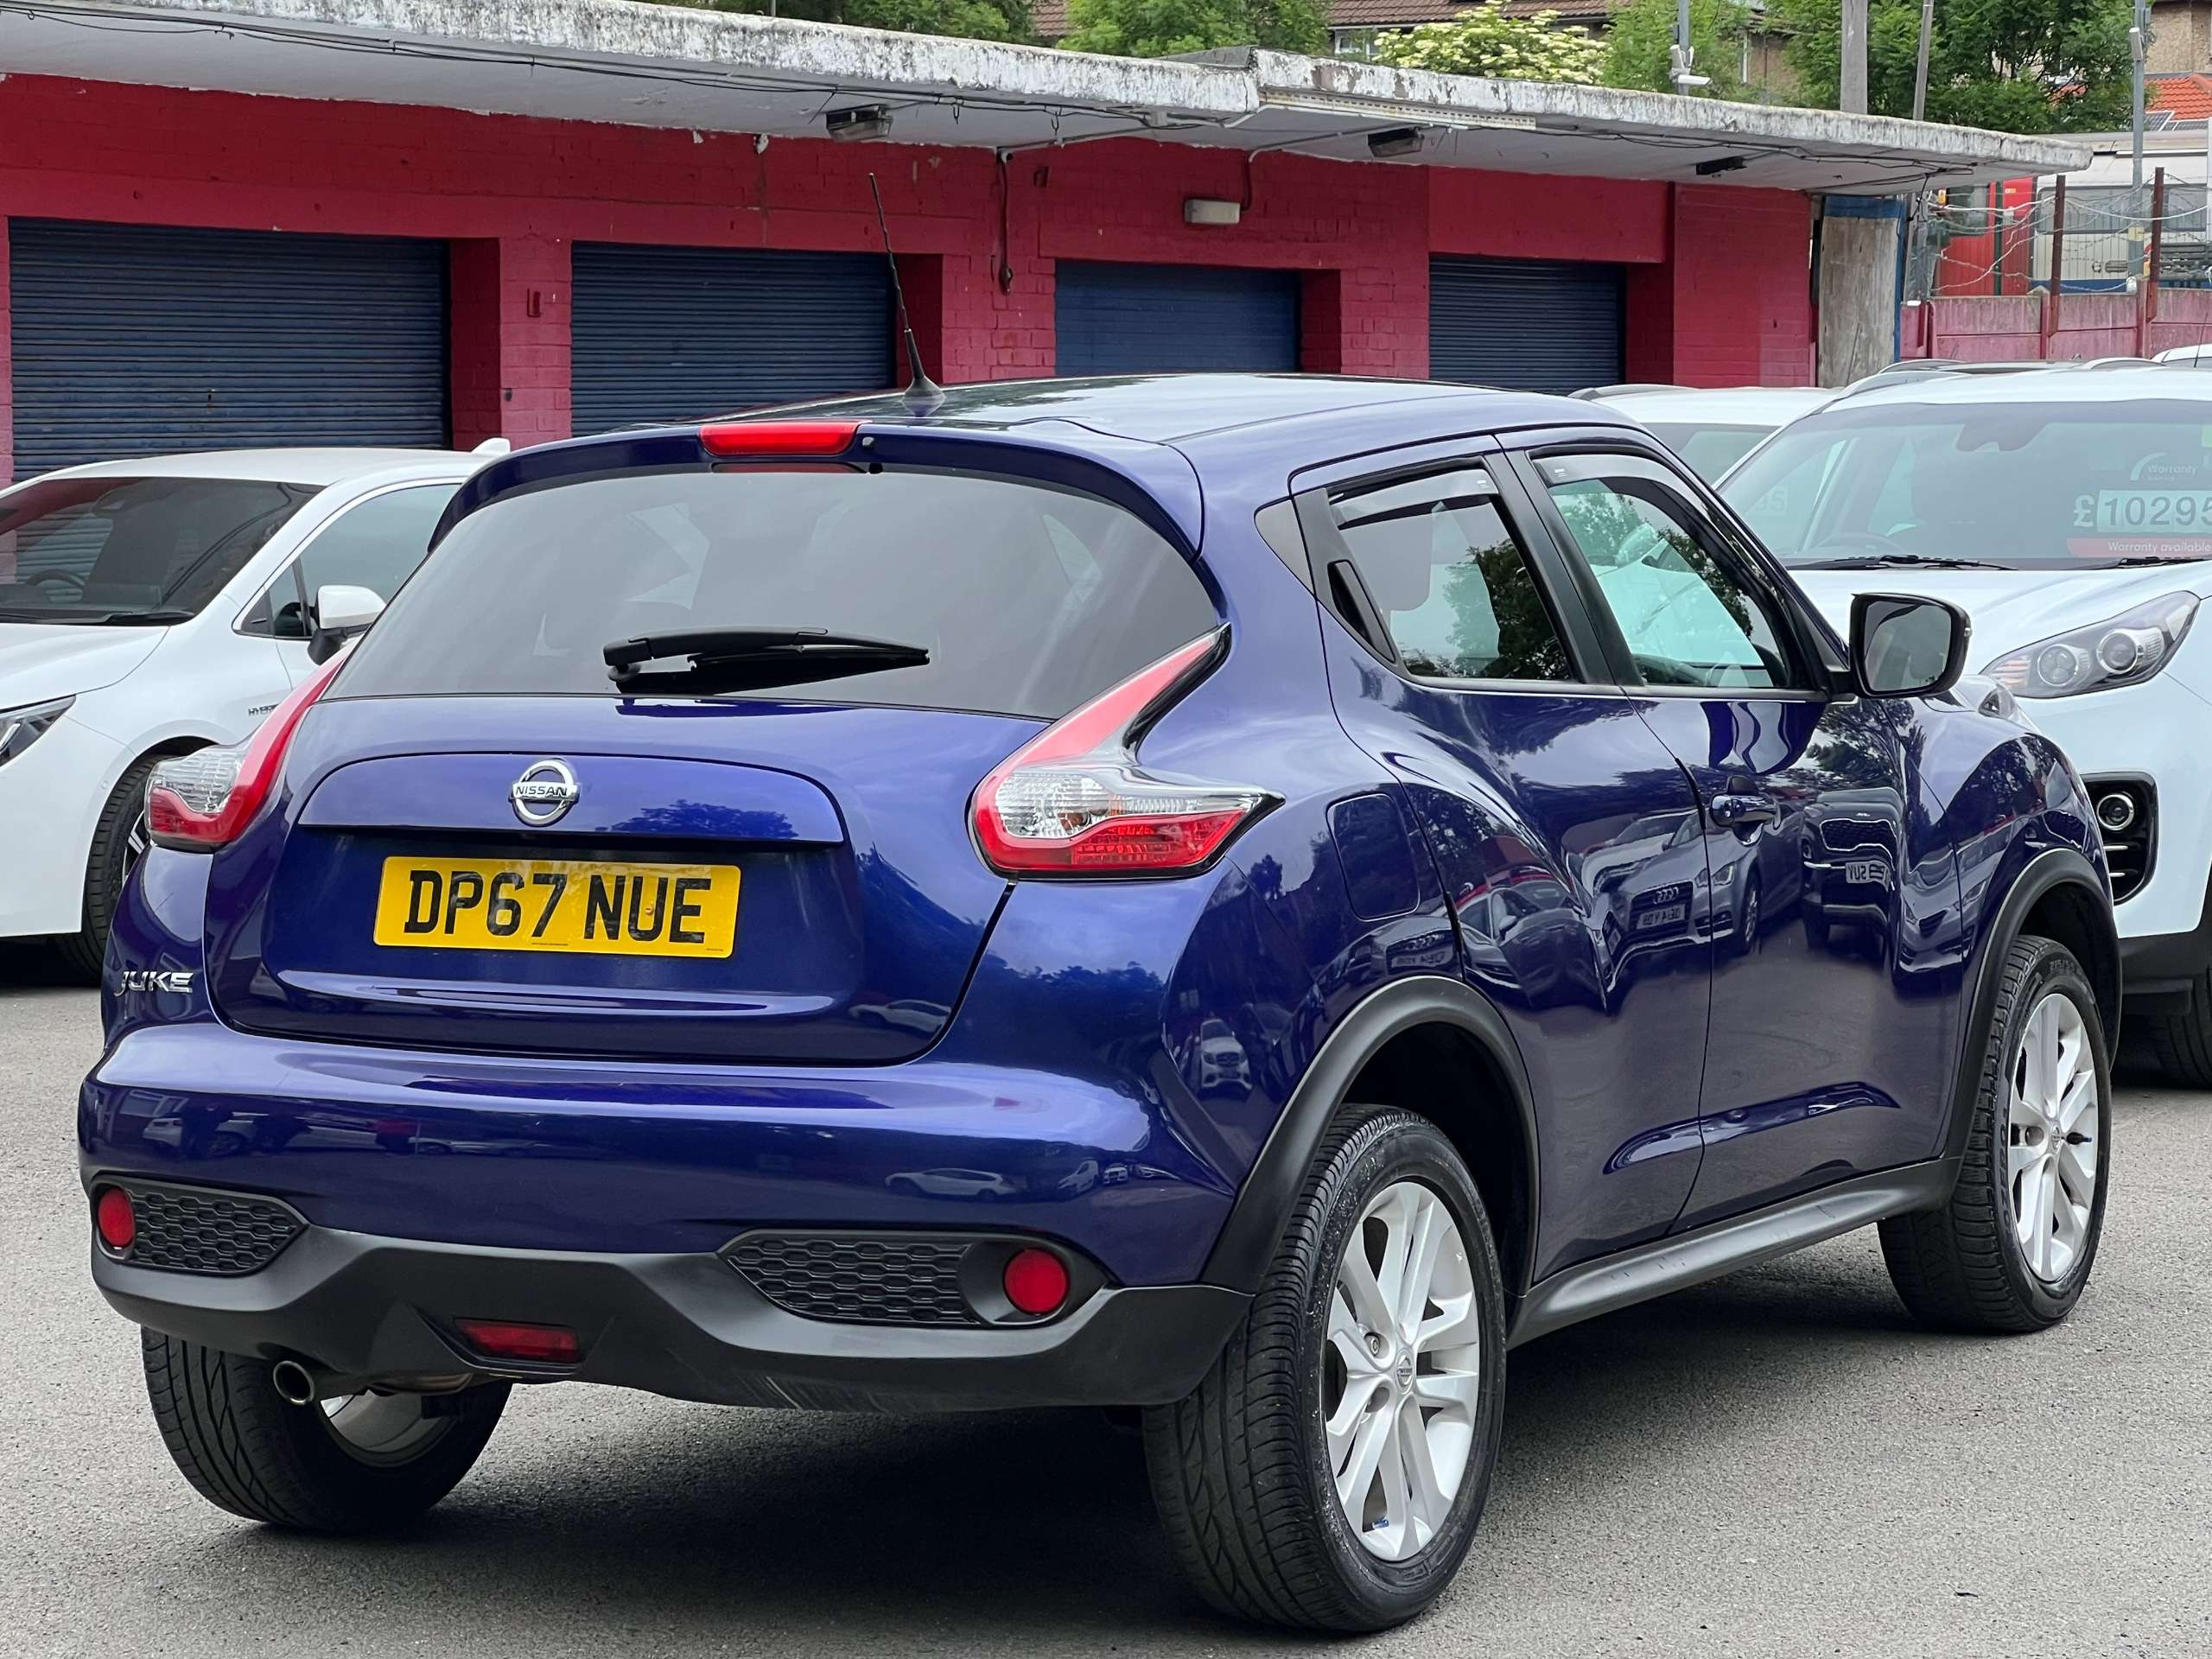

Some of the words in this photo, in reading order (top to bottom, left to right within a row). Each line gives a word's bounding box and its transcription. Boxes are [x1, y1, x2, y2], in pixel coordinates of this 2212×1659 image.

[2107, 541, 2158, 553] Warranty
[2160, 541, 2212, 552] available
[515, 785, 568, 797] NISSAN
[403, 869, 568, 938] DP67
[583, 874, 712, 944] NUE
[113, 970, 194, 997] JUKE
